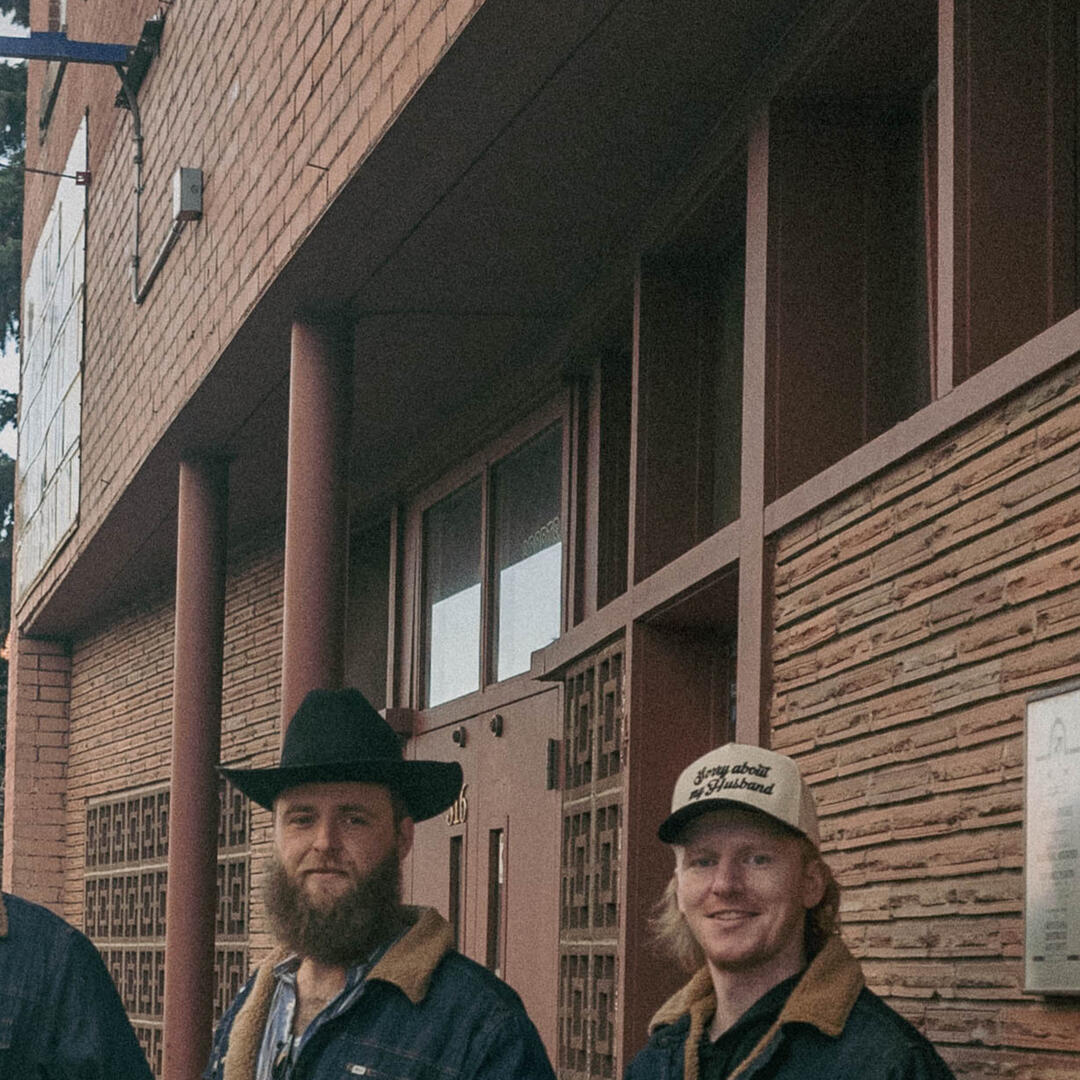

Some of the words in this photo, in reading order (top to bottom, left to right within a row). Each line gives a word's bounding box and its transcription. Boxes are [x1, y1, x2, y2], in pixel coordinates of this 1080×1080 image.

[693, 766, 730, 786] Sorry
[731, 761, 772, 778] about
[705, 777, 776, 796] Husband
